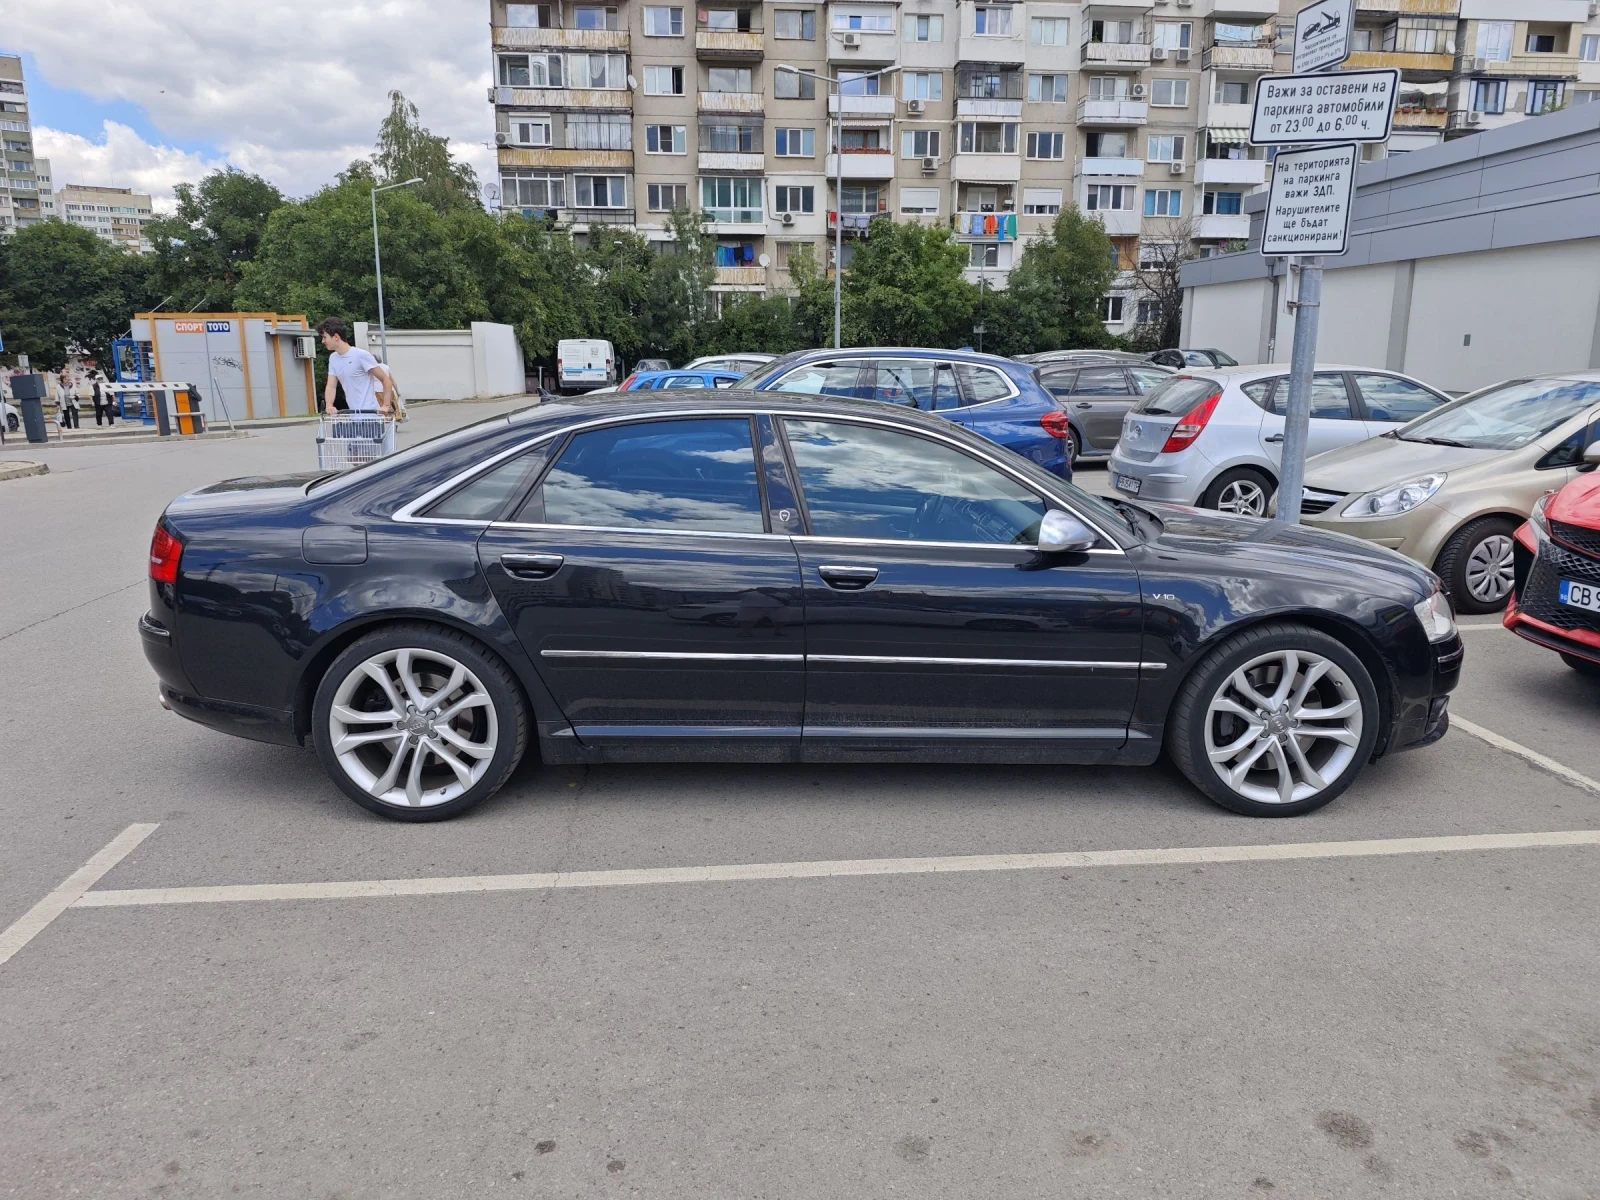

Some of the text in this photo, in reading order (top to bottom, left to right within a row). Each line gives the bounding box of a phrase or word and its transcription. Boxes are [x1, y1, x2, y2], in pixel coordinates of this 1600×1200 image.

[1267, 81, 1386, 99] Важи за оставени на
[1263, 98, 1384, 119] паркинга автомобили
[1270, 123, 1282, 133] от
[1316, 121, 1331, 133] до
[1361, 119, 1370, 131] ч.
[1277, 157, 1350, 172] На територията
[1283, 172, 1340, 186] на паркинга
[1285, 185, 1335, 199] важи ЗДП.
[1275, 204, 1340, 218] Нарушителите
[1283, 217, 1328, 229] ще бъдат
[1267, 230, 1342, 243] санкционирани!
[175, 322, 230, 332] СПОРТ ТОТО
